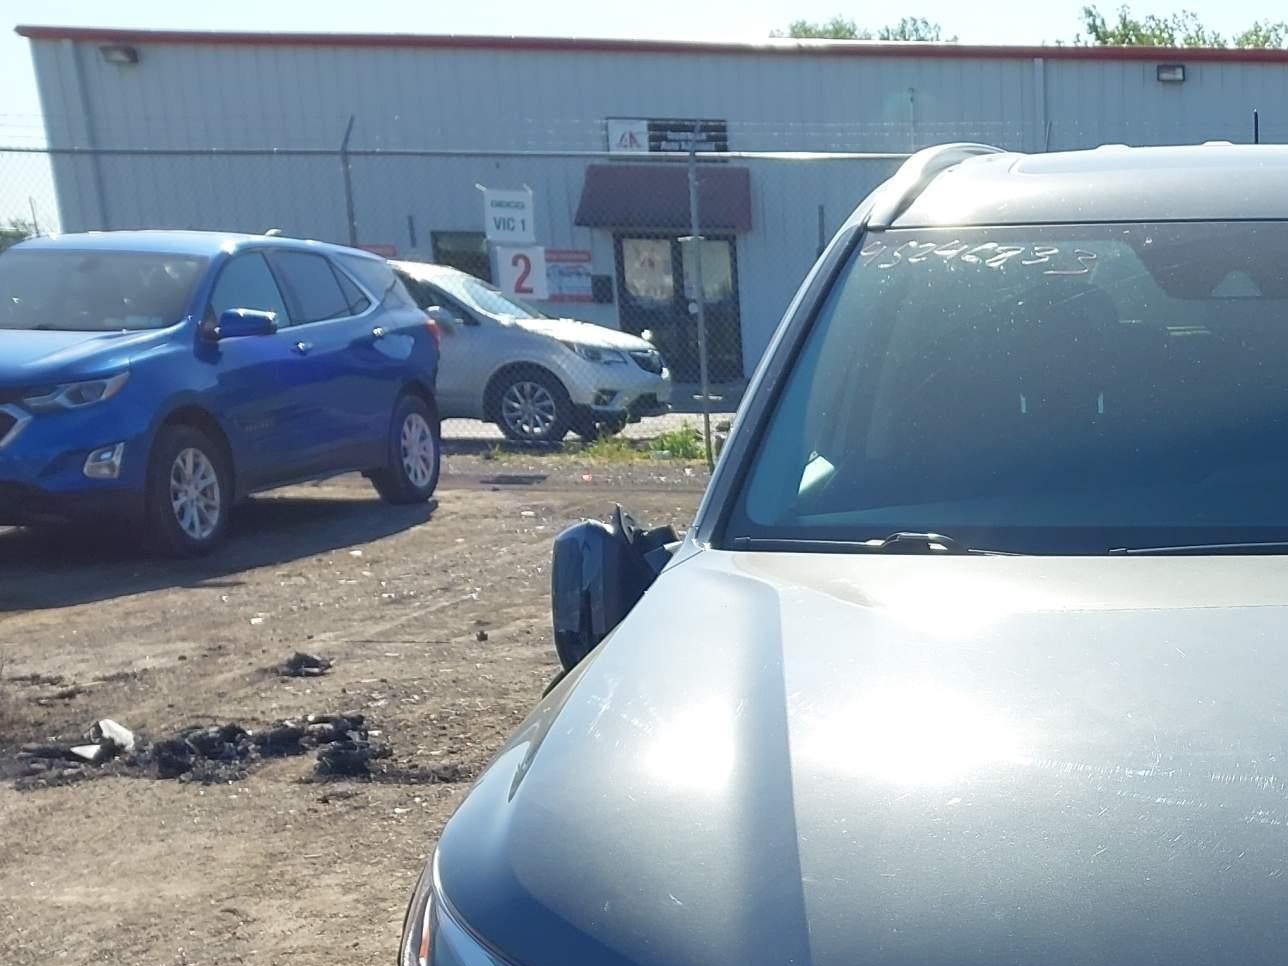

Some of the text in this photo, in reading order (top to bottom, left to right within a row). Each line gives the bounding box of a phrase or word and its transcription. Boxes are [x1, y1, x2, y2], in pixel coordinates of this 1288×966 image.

[493, 216, 526, 232] VIC 1
[511, 253, 534, 294] 2
